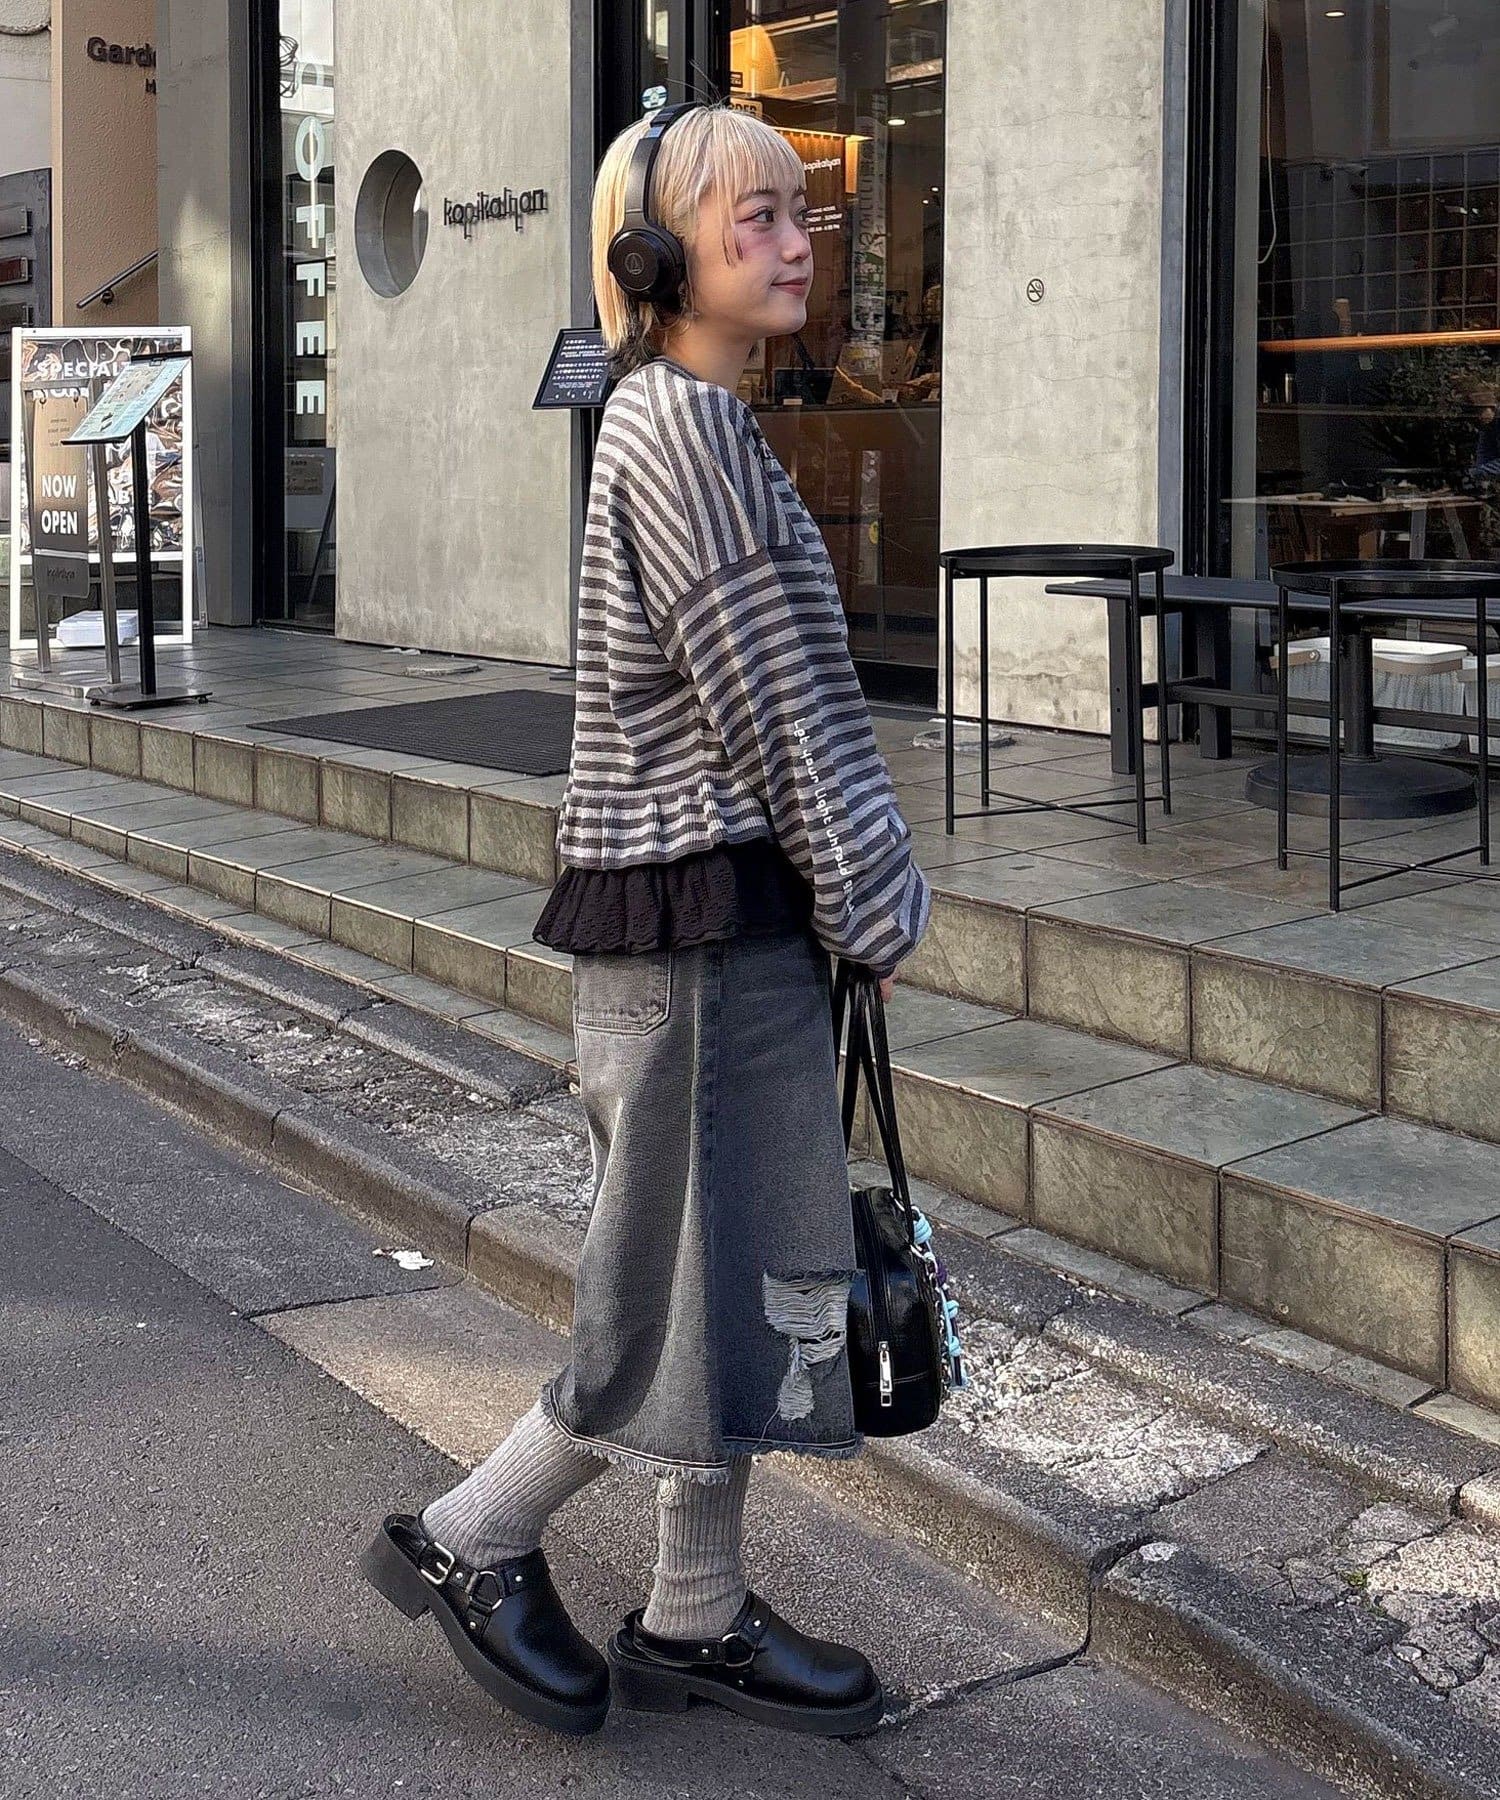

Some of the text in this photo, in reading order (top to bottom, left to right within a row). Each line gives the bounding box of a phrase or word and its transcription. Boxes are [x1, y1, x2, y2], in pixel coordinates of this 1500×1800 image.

[87, 36, 154, 68] Gard
[443, 187, 549, 240] kopikalyan
[37, 360, 132, 379] SPECIALT
[41, 475, 77, 498] NOW
[41, 509, 78, 535] OPEN
[793, 717, 810, 744] Let
[800, 749, 819, 783] your
